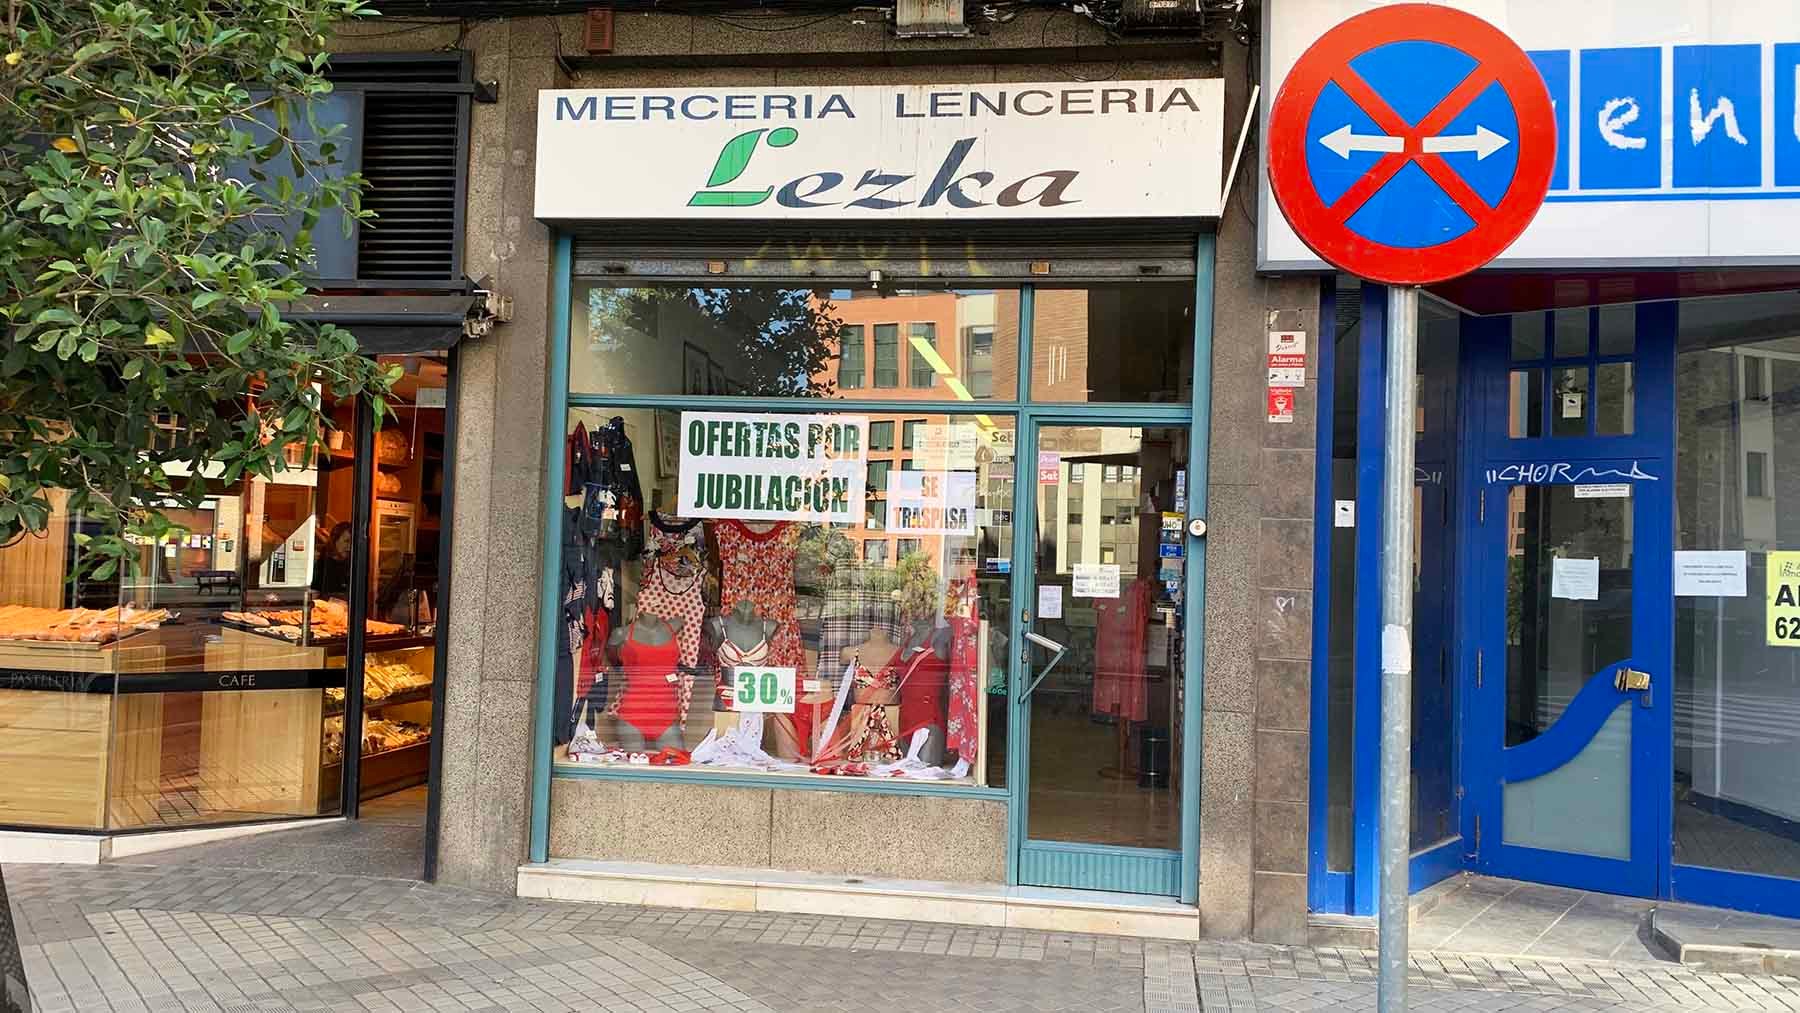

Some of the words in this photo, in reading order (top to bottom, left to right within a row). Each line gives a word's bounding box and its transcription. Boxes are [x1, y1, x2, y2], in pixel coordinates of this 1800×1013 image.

[556, 94, 856, 121] MERCERIA
[896, 87, 1201, 118] LENCERIA
[687, 127, 1082, 209] Lezka
[1271, 354, 1304, 364] Alarma
[688, 420, 800, 459] OFERTAS
[807, 423, 861, 460] POR
[694, 468, 849, 513] JUBILACIÓN
[921, 475, 939, 497] SE
[219, 674, 256, 687] CAFE
[738, 672, 793, 705] 30%
